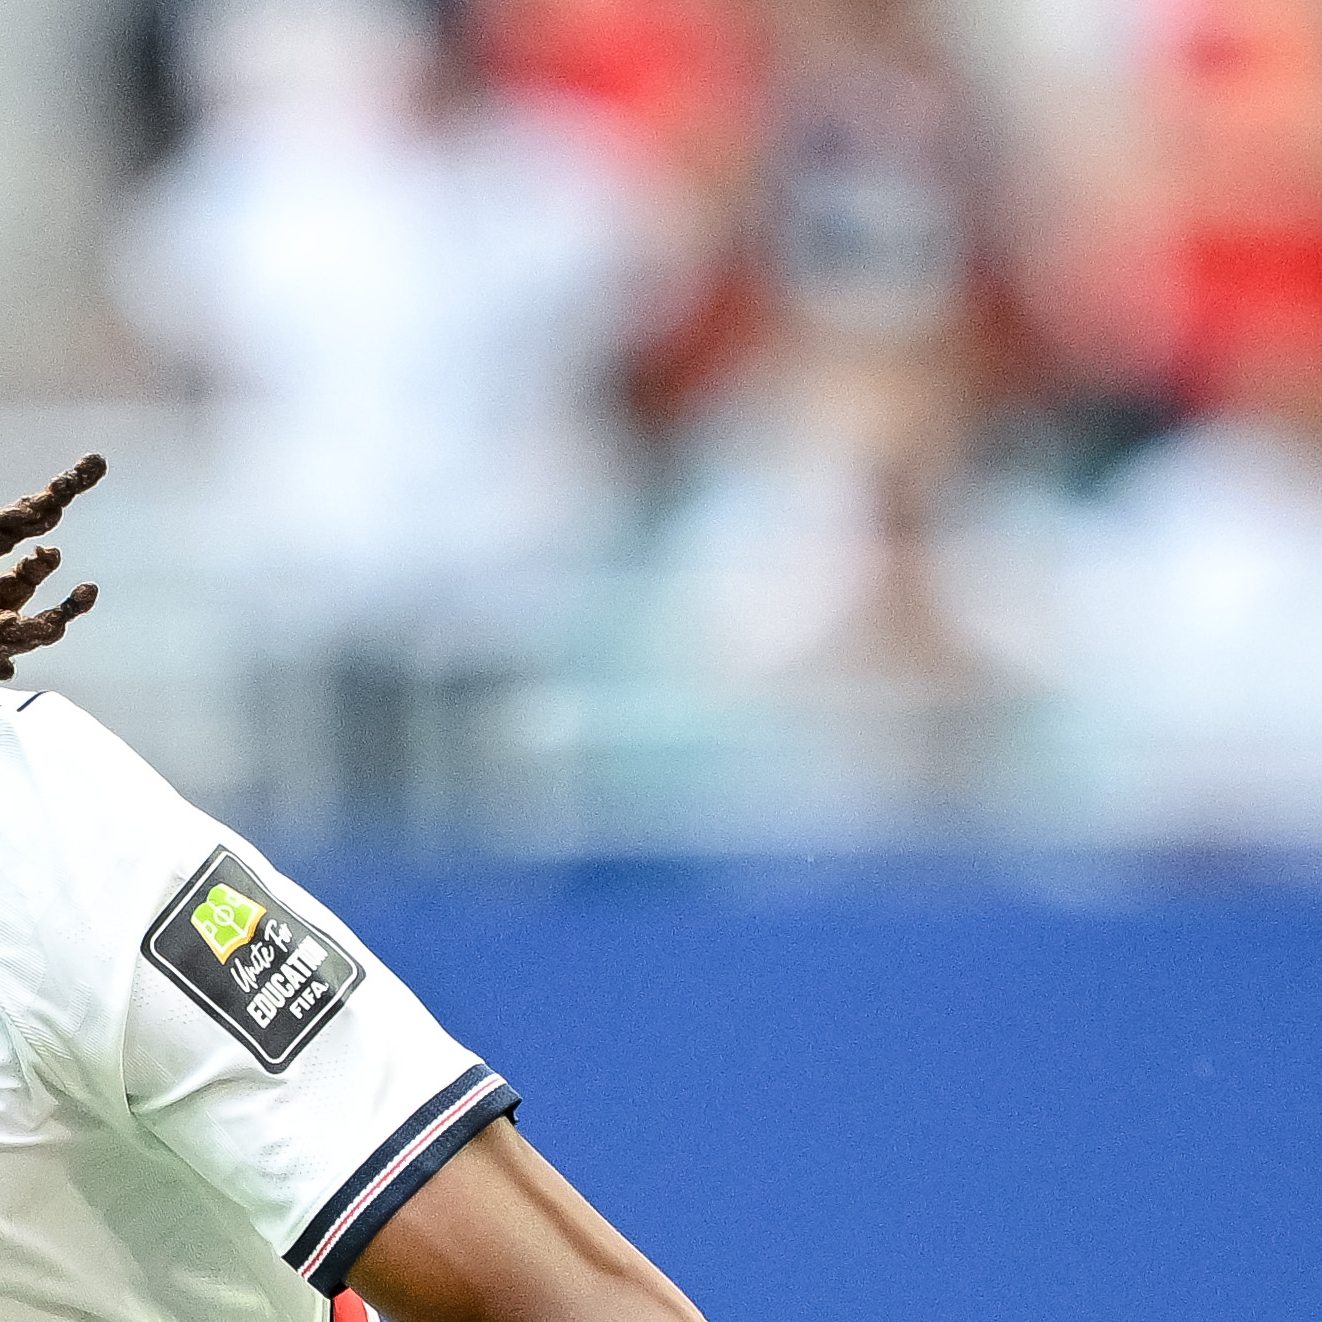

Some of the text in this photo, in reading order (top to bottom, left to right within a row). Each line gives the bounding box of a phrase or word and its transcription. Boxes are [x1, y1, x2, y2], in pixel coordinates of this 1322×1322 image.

[230, 919, 293, 993] Unite For
[289, 981, 328, 1020] FIFA
